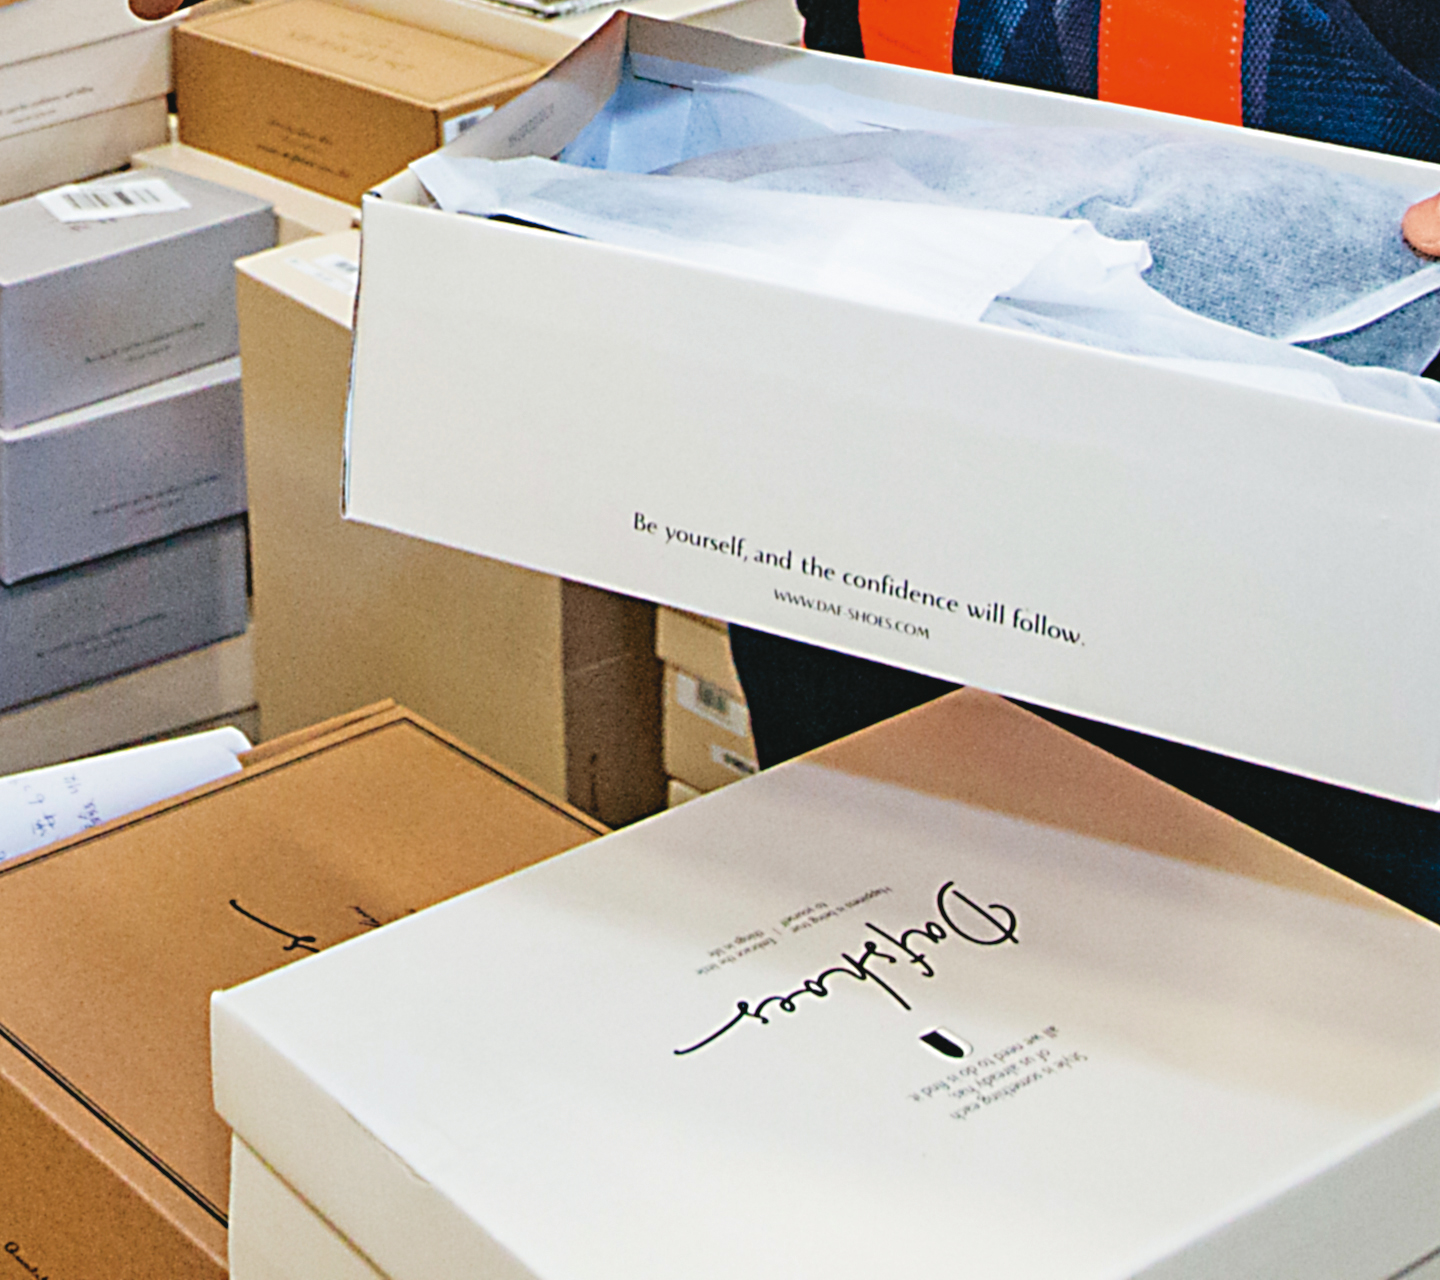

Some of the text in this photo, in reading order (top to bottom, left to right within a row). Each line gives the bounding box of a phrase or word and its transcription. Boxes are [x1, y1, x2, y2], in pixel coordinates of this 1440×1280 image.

[632, 511, 1086, 647] Be yourself, and the confidence will follow.
[773, 588, 930, 639] WWW.DAF-SHOES.COM
[673, 880, 1020, 1057] Dafshoes
